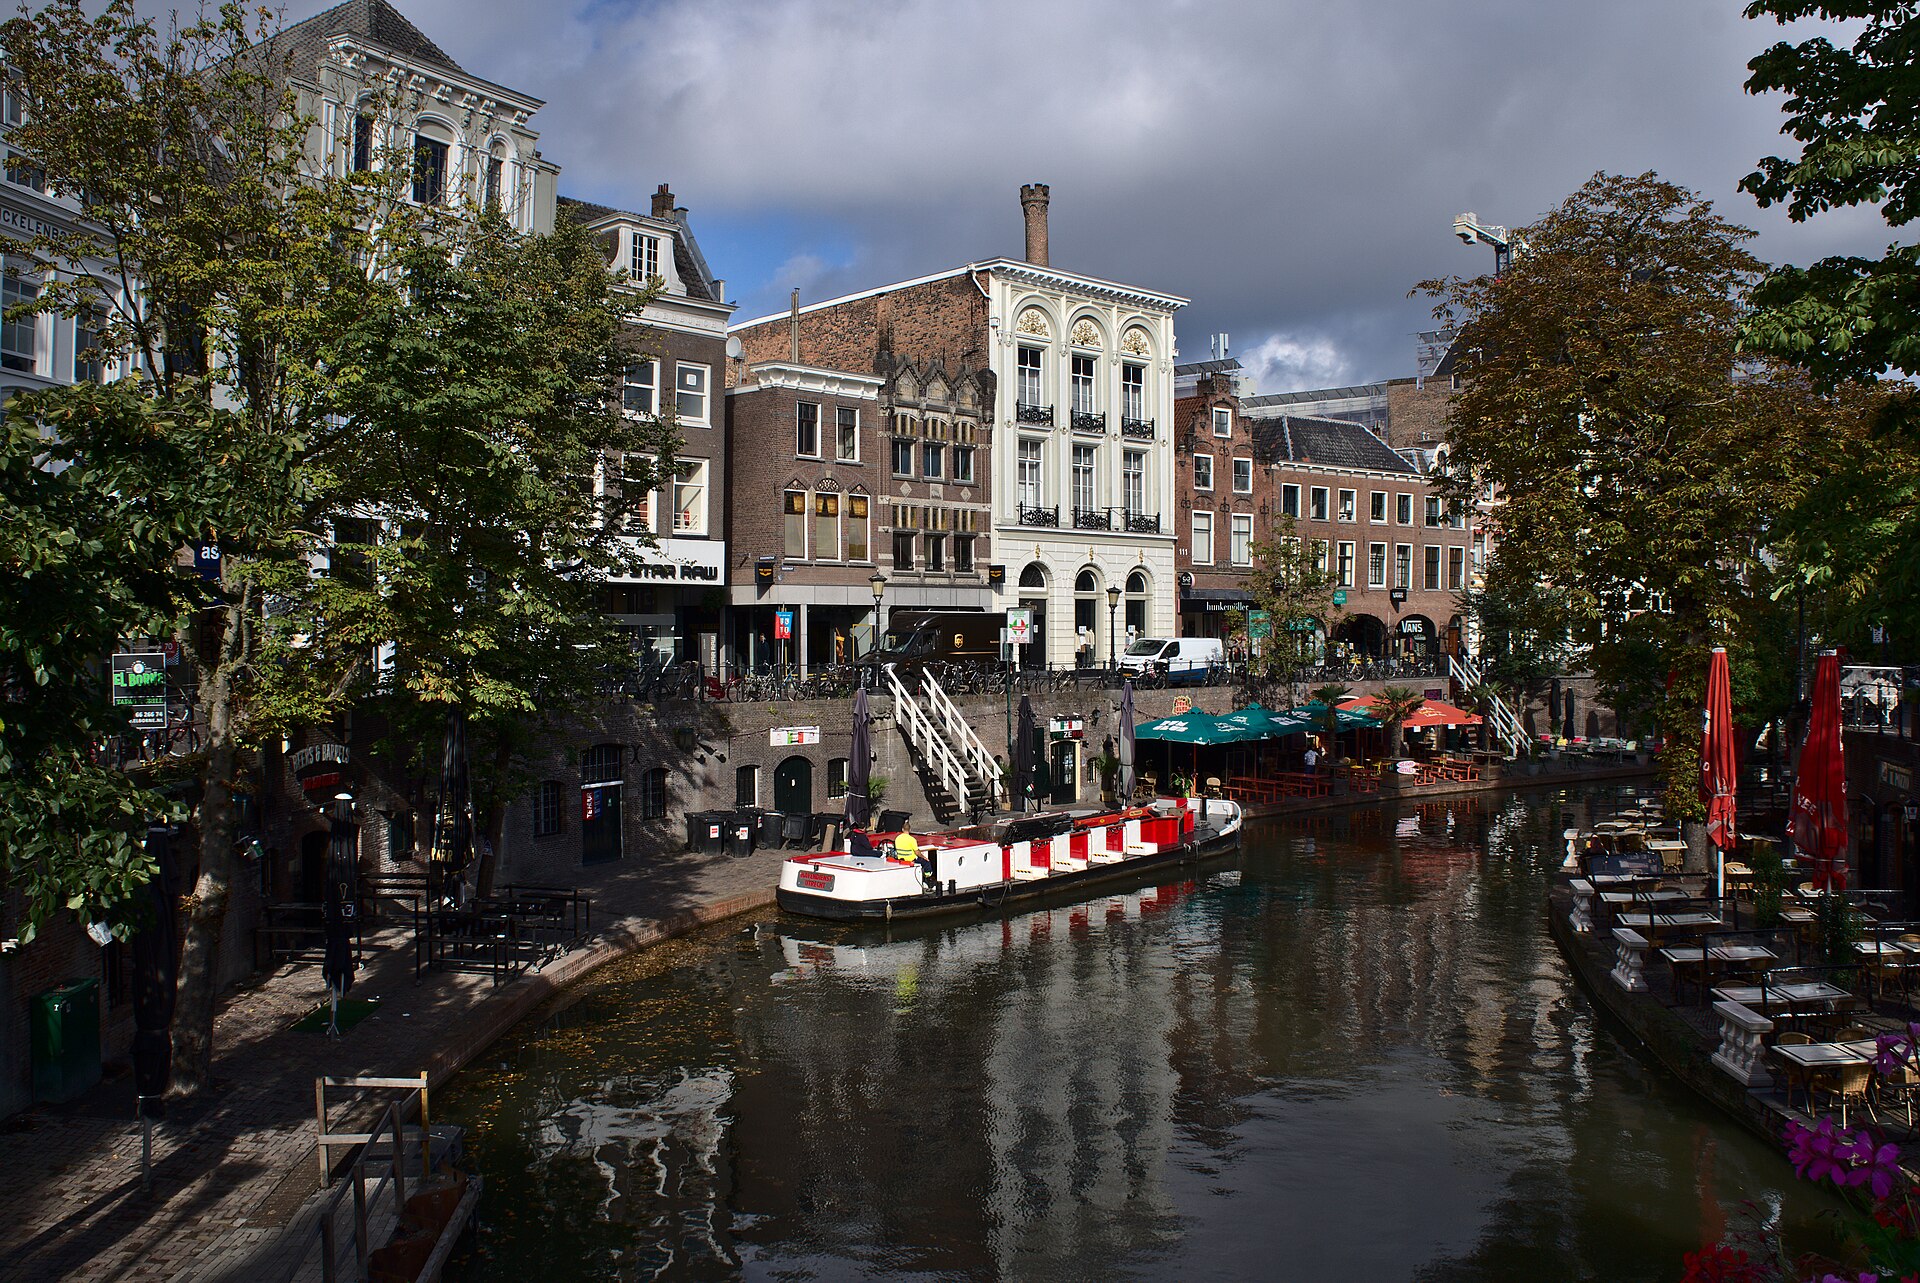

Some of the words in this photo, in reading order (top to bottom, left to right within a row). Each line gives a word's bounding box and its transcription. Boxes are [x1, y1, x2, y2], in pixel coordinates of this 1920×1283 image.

[680, 565, 718, 581] RAW
[1206, 601, 1249, 611] hunkemöller
[1401, 620, 1423, 633] VANS
[114, 672, 127, 687] EL
[586, 810, 593, 819] TE
